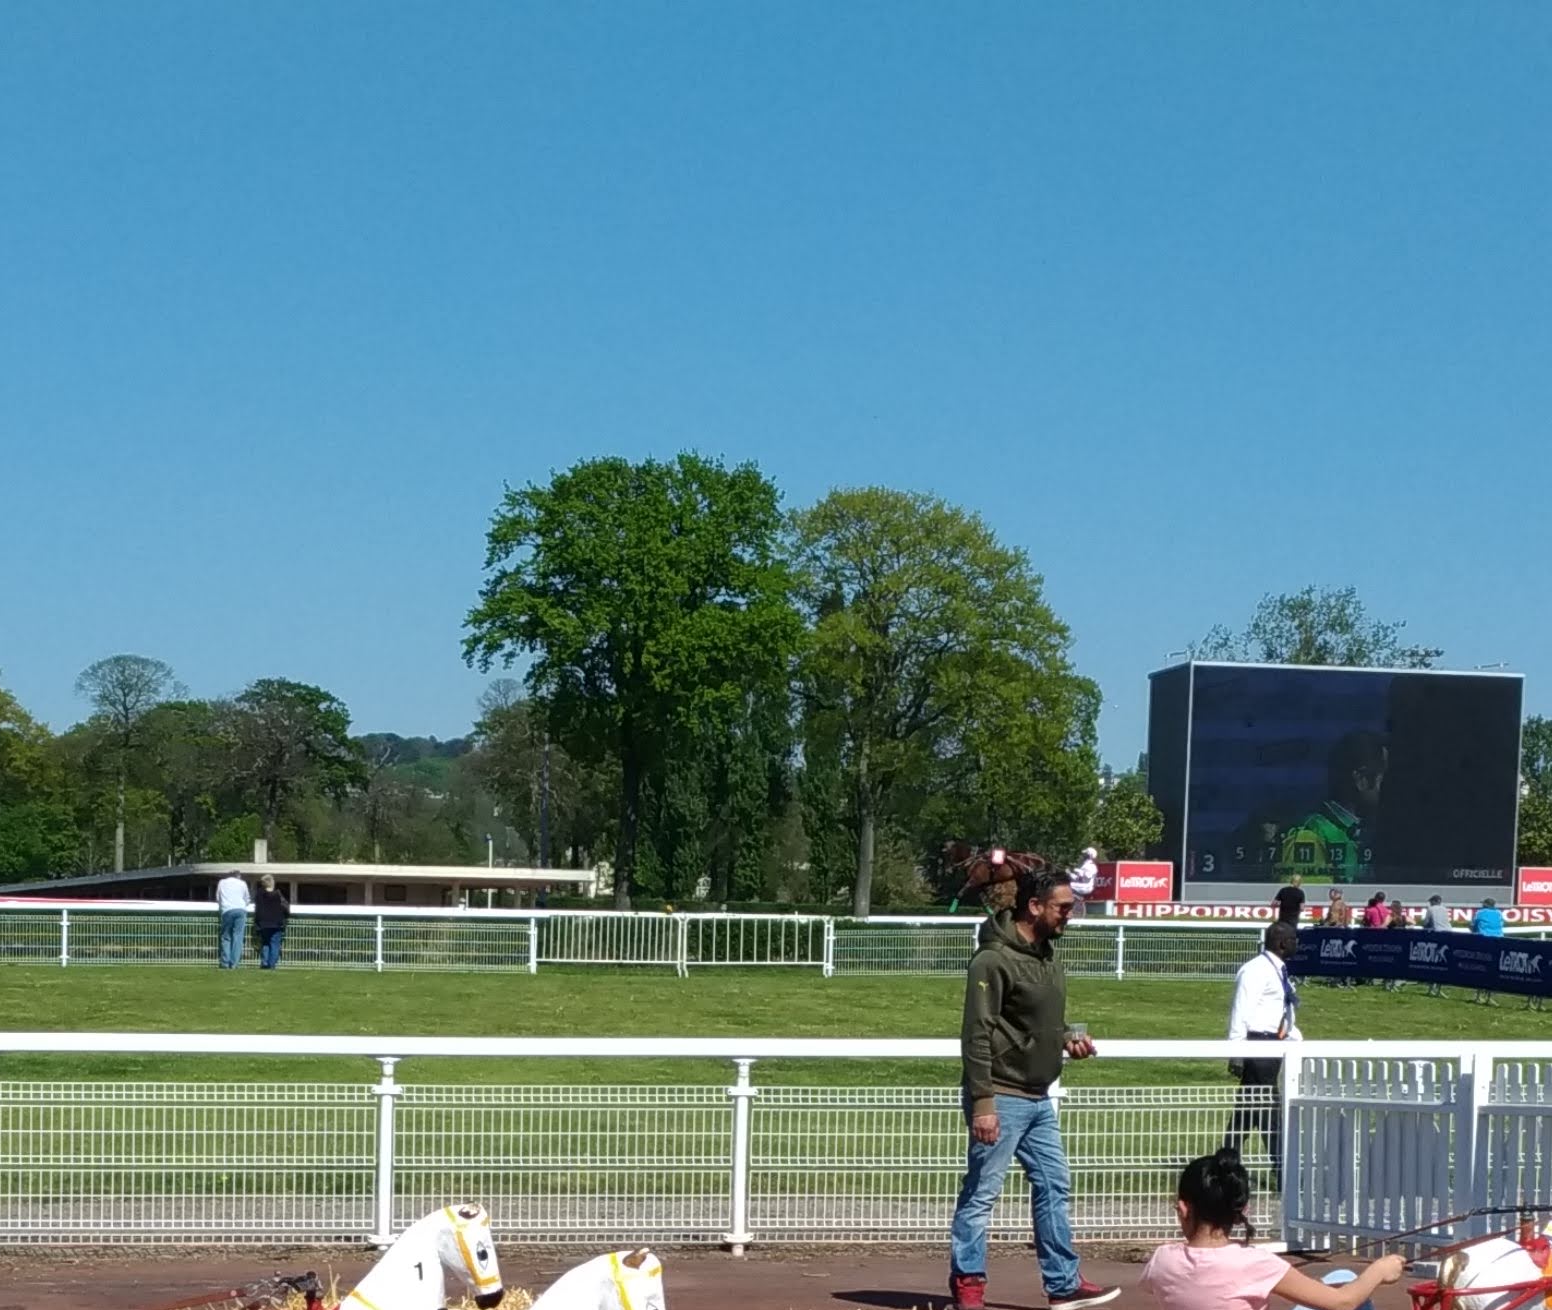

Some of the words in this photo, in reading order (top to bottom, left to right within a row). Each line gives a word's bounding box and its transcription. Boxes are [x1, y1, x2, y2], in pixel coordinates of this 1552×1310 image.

[1236, 847, 1245, 859] 5
[1268, 848, 1277, 859] 7
[1299, 848, 1311, 860] 11
[1330, 848, 1344, 861] 13
[1363, 848, 1372, 861] 9
[1202, 854, 1215, 872] 3
[1452, 868, 1504, 879] OFFICIELLE
[1120, 876, 1156, 888] LeTROT
[1123, 904, 1313, 919] HIPPODROE
[414, 1262, 424, 1281] 1
